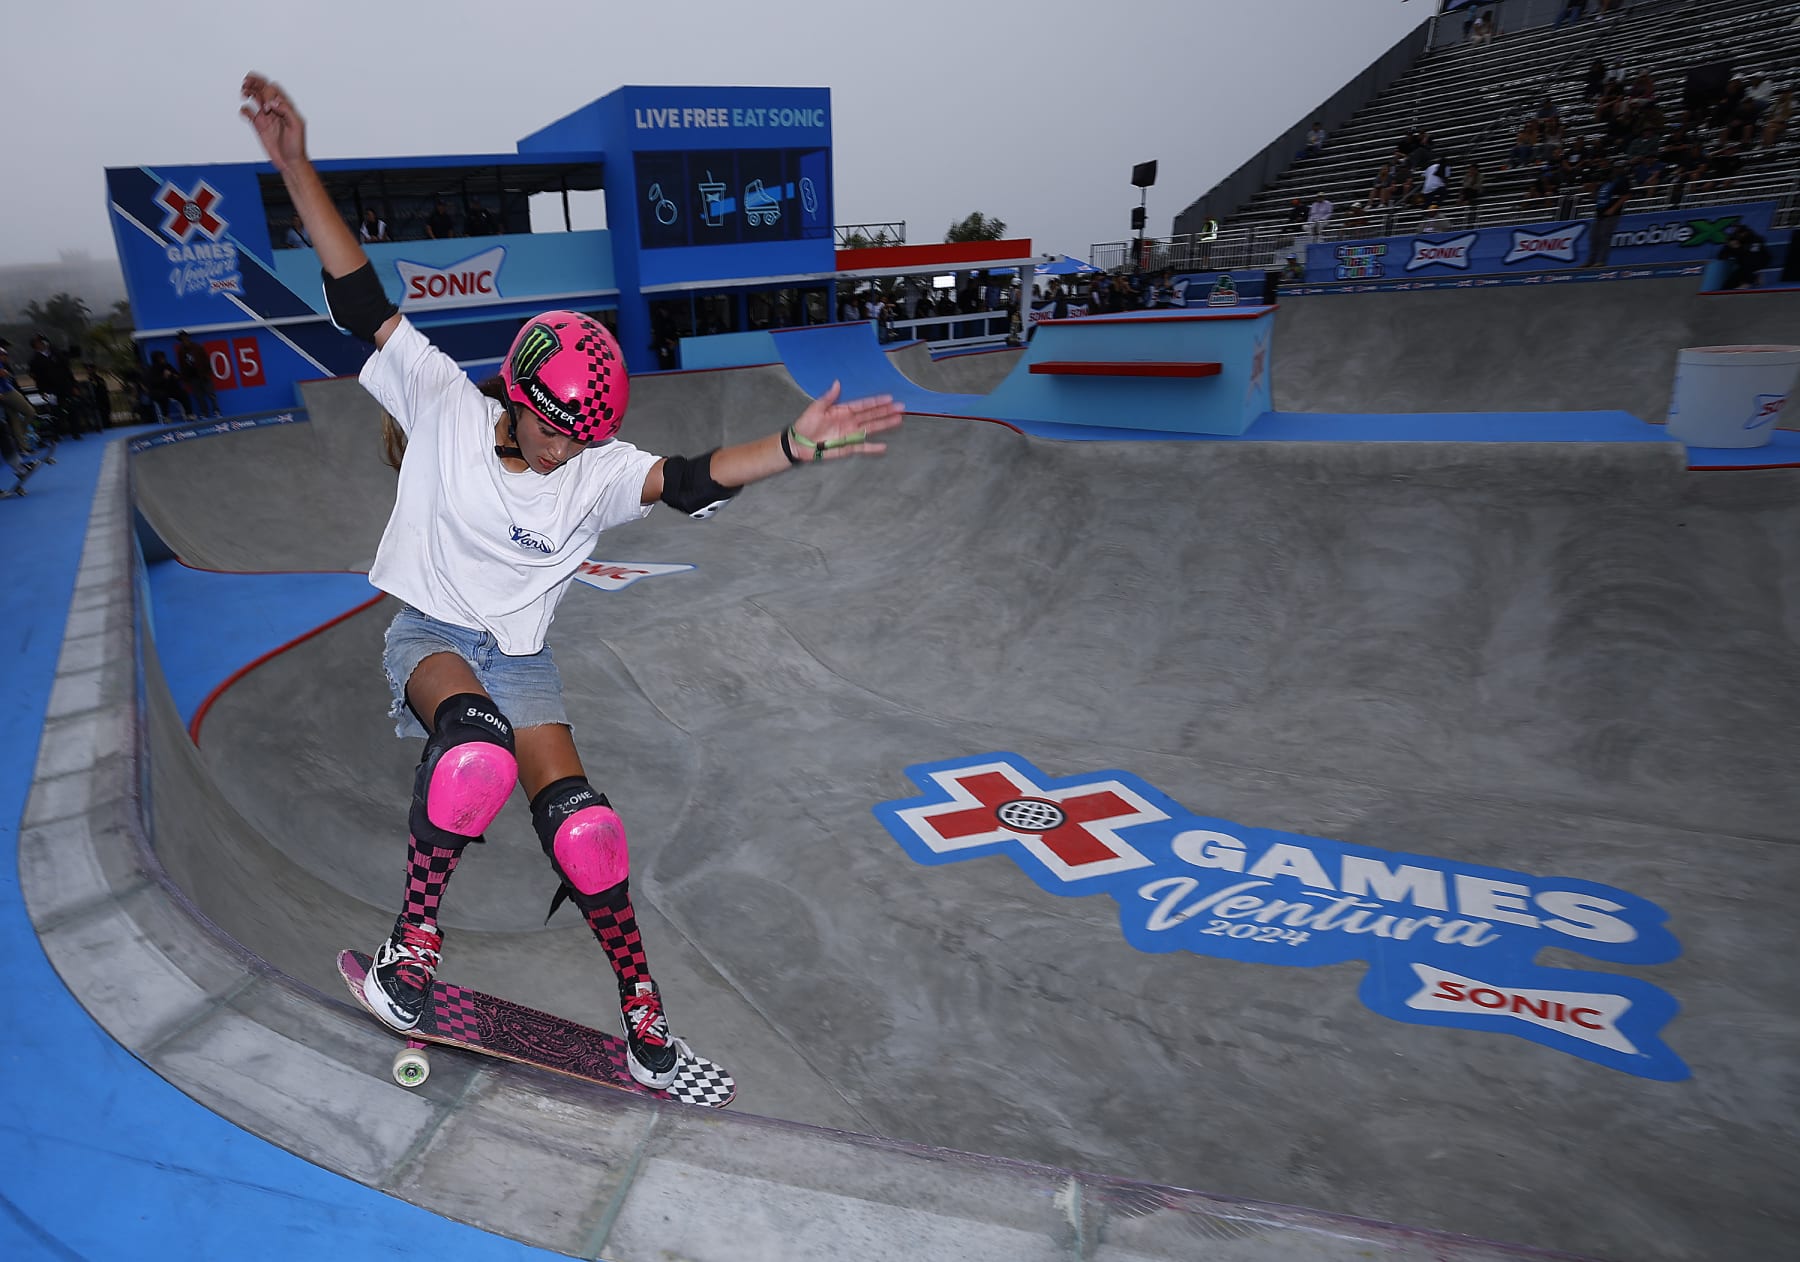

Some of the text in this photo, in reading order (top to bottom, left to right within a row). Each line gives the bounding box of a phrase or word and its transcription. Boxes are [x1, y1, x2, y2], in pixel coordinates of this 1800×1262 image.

[635, 108, 825, 128] LIVE FREE EAT SONIC
[167, 242, 236, 263] GAMES
[1416, 246, 1465, 260] SONIC
[1514, 237, 1572, 252] SONIC
[408, 270, 492, 299] SONIC
[1171, 829, 1638, 944] GAMES
[1137, 876, 1502, 947] Ventura
[1199, 919, 1312, 947] 2024
[1432, 981, 1606, 1031] SONIC
